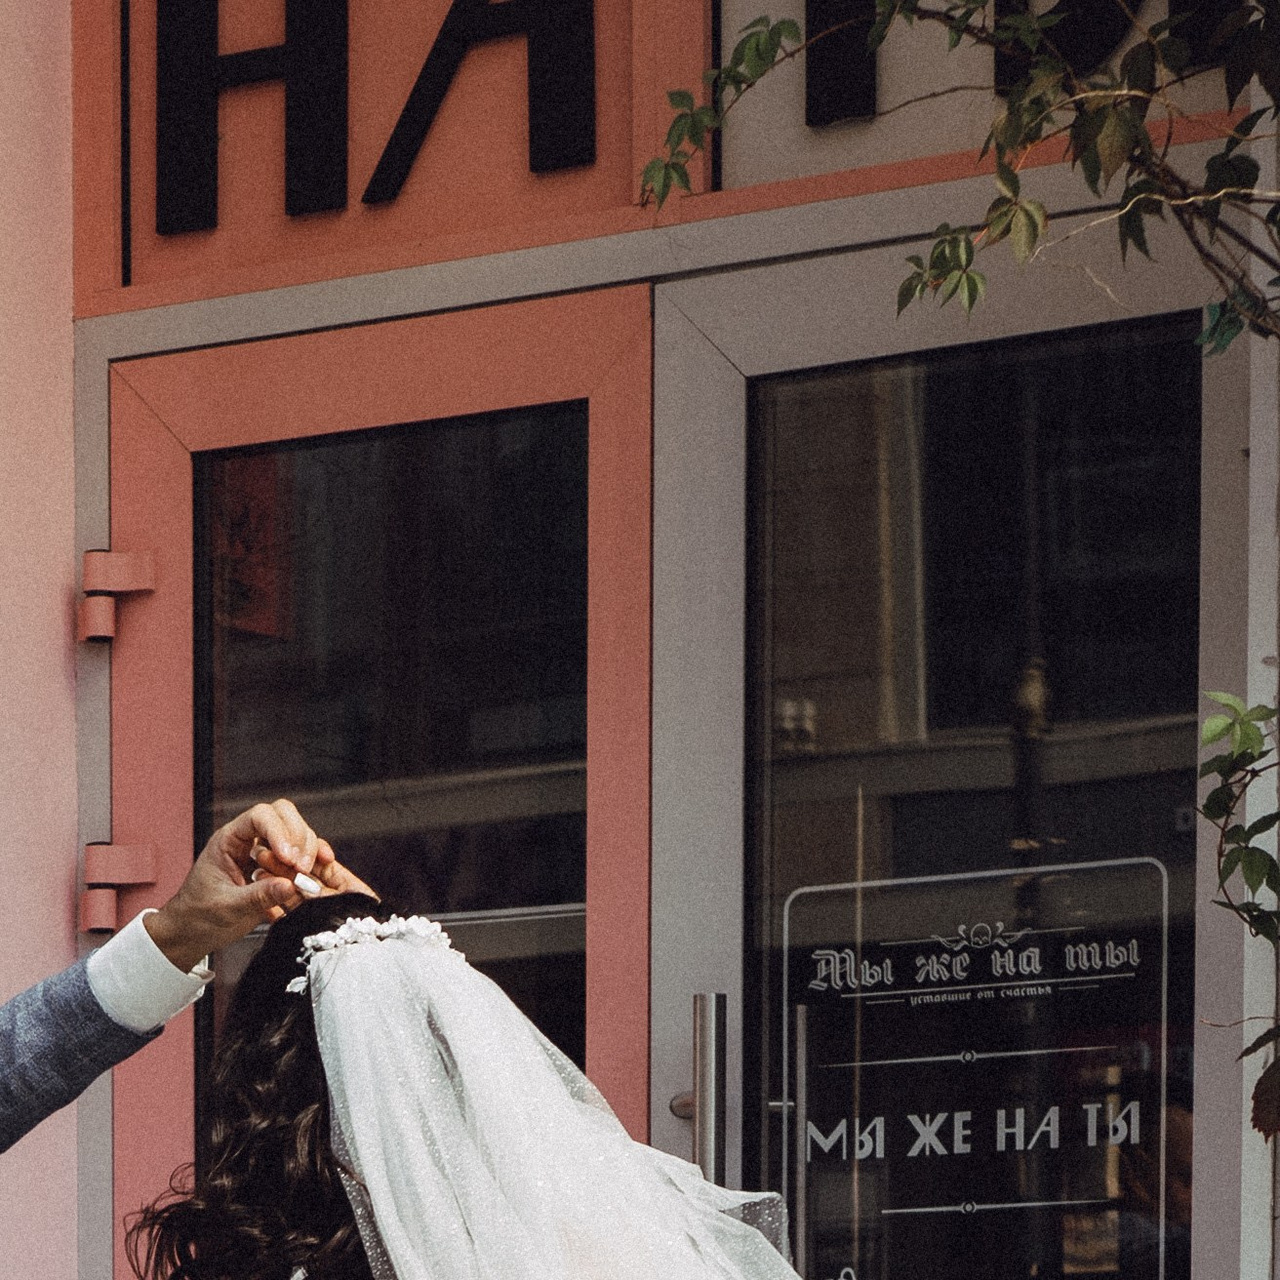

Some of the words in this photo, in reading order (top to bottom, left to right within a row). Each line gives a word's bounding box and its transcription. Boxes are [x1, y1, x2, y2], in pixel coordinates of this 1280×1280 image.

[808, 949, 894, 990] Мы
[915, 953, 970, 982] же
[991, 946, 1042, 977] на
[907, 1111, 971, 1157] ЖЕ
[996, 1105, 1059, 1151] НА
